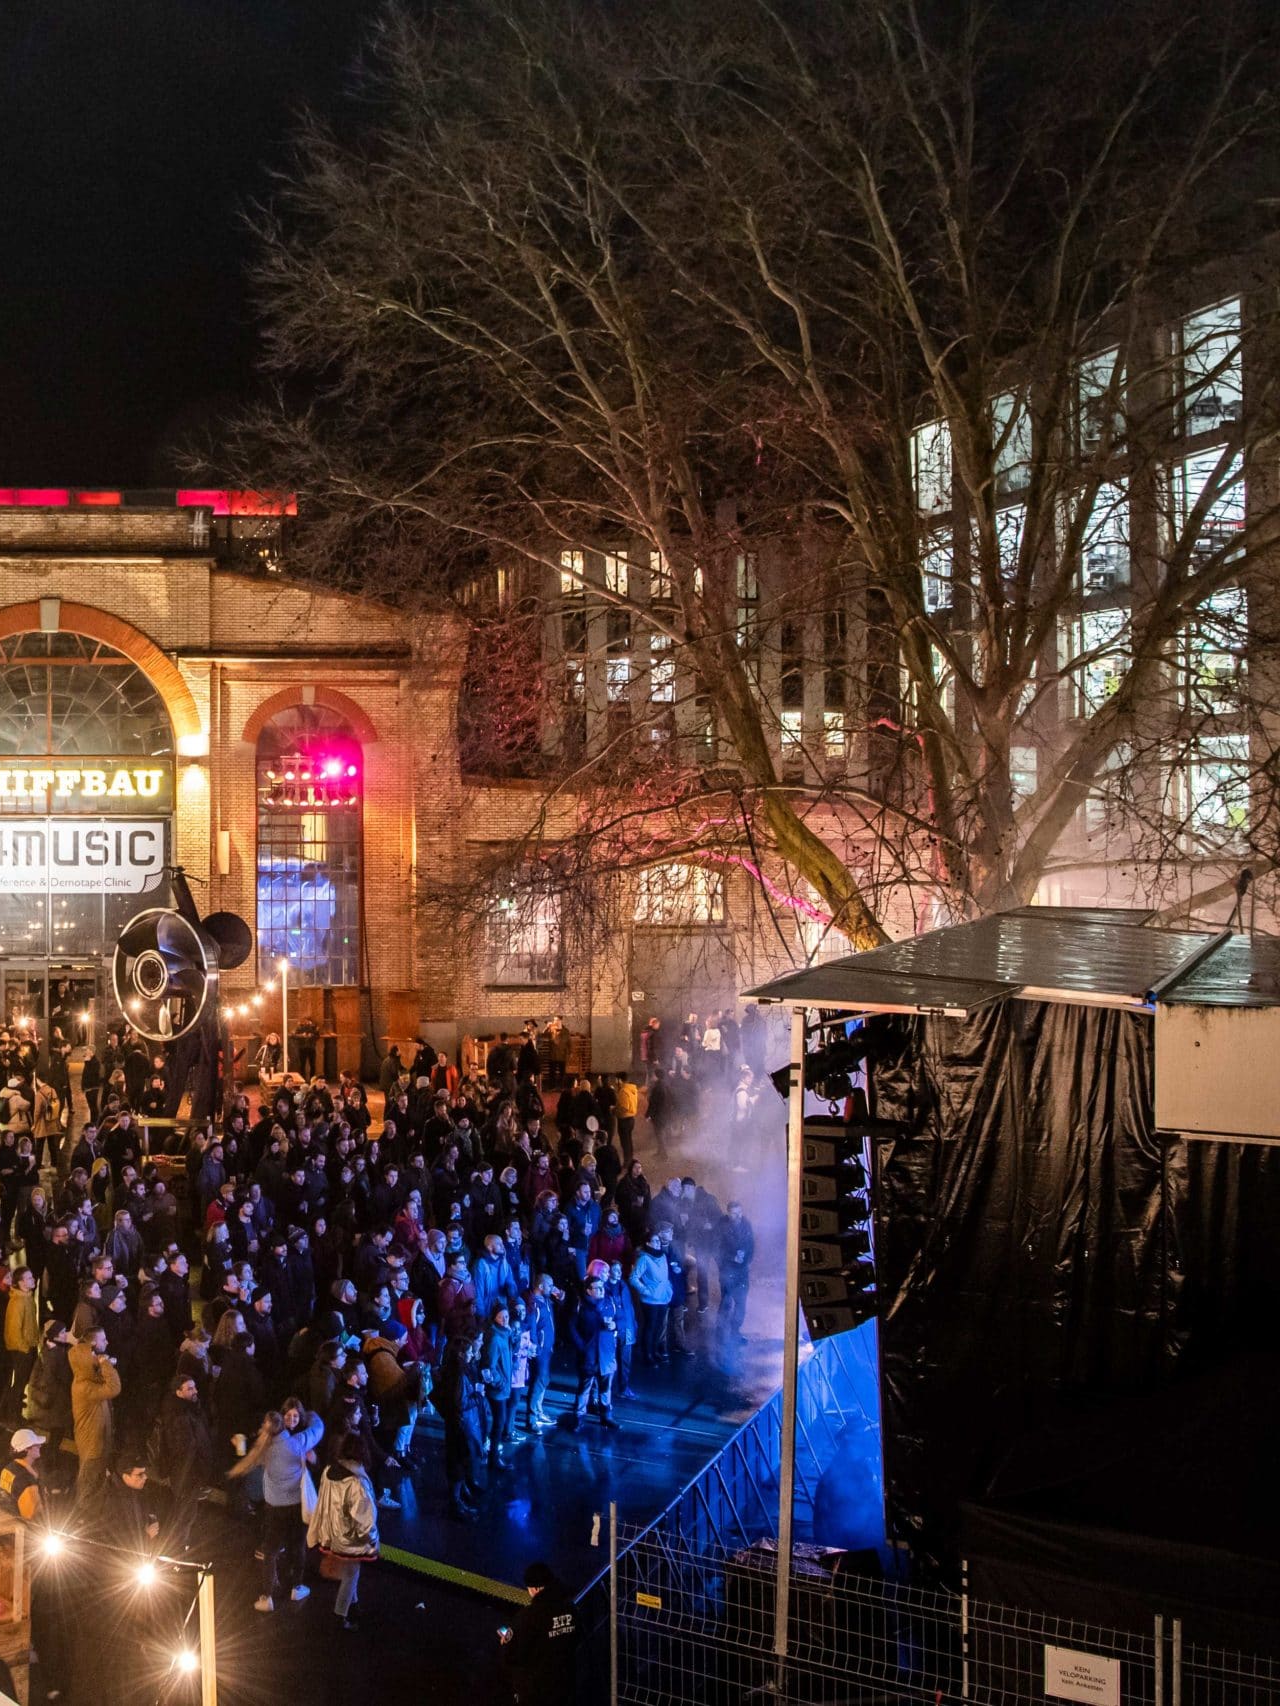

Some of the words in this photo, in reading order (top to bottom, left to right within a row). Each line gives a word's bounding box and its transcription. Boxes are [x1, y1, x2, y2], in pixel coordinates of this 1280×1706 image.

[39, 878, 48, 888] &
[50, 877, 103, 890] Demotape
[104, 877, 132, 888] Clinic
[1074, 1665, 1091, 1674] KEIN
[1058, 1669, 1106, 1685] VELOPARKING
